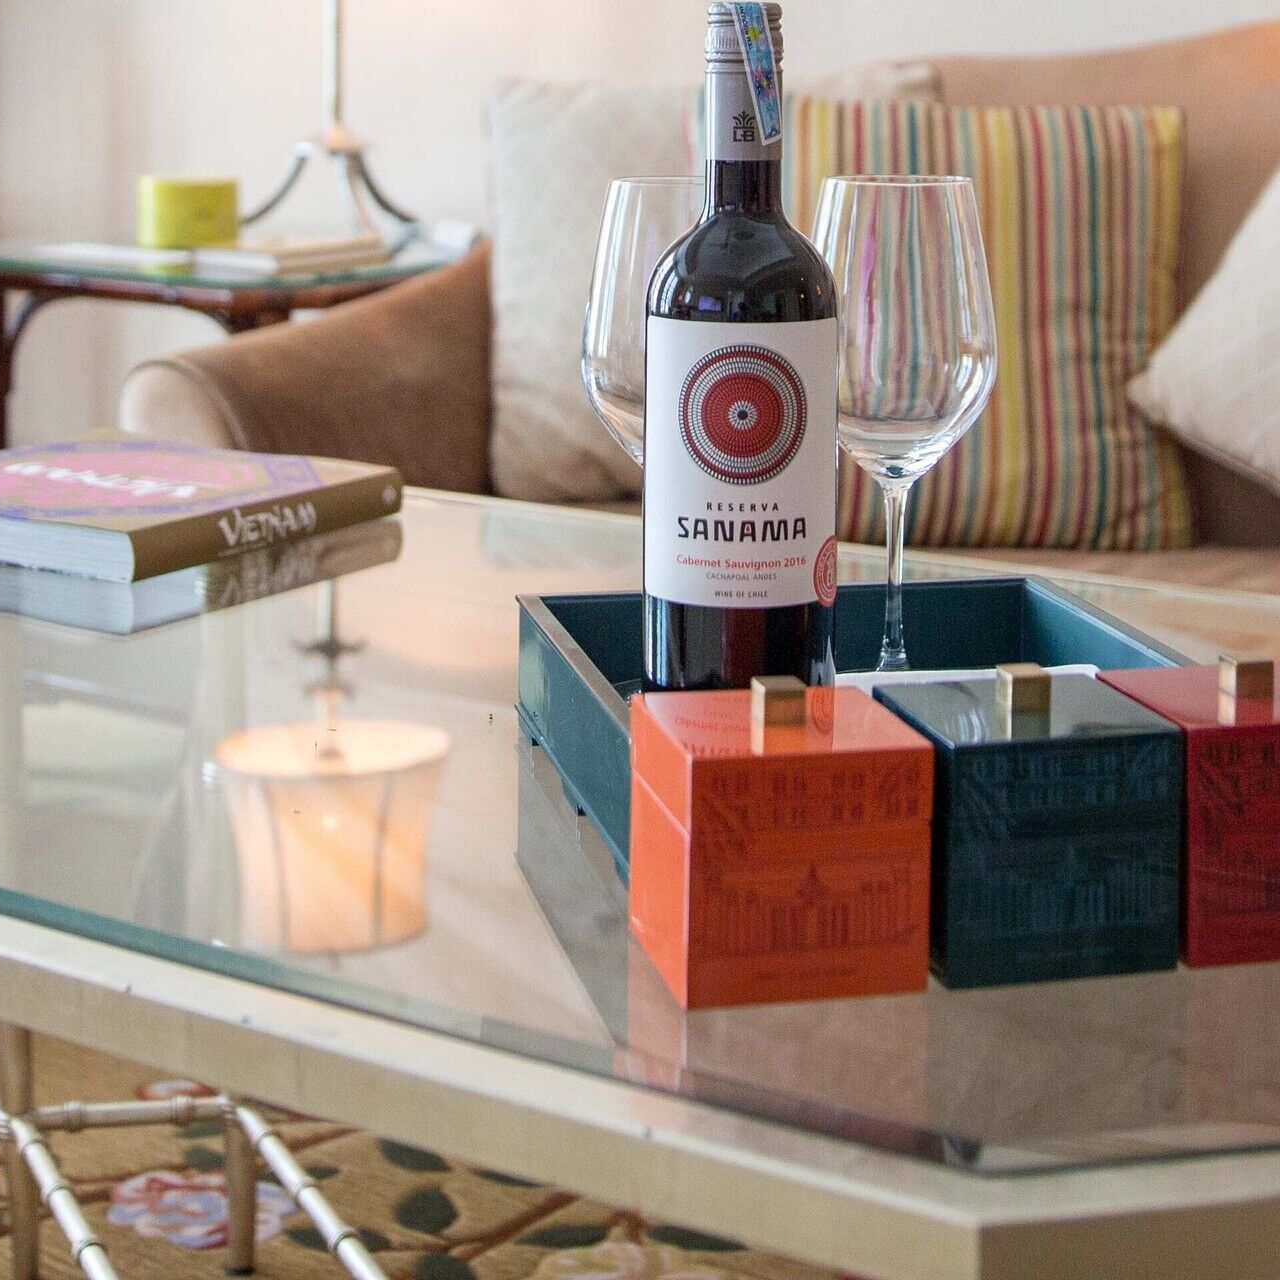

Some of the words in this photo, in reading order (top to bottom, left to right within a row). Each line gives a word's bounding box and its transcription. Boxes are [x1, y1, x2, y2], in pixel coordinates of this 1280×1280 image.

[706, 502, 779, 512] RESERVA
[677, 516, 806, 542] SANAMA
[677, 554, 721, 568] Cabernet
[725, 558, 781, 570] Sauvignon
[748, 590, 768, 598] CHILE
